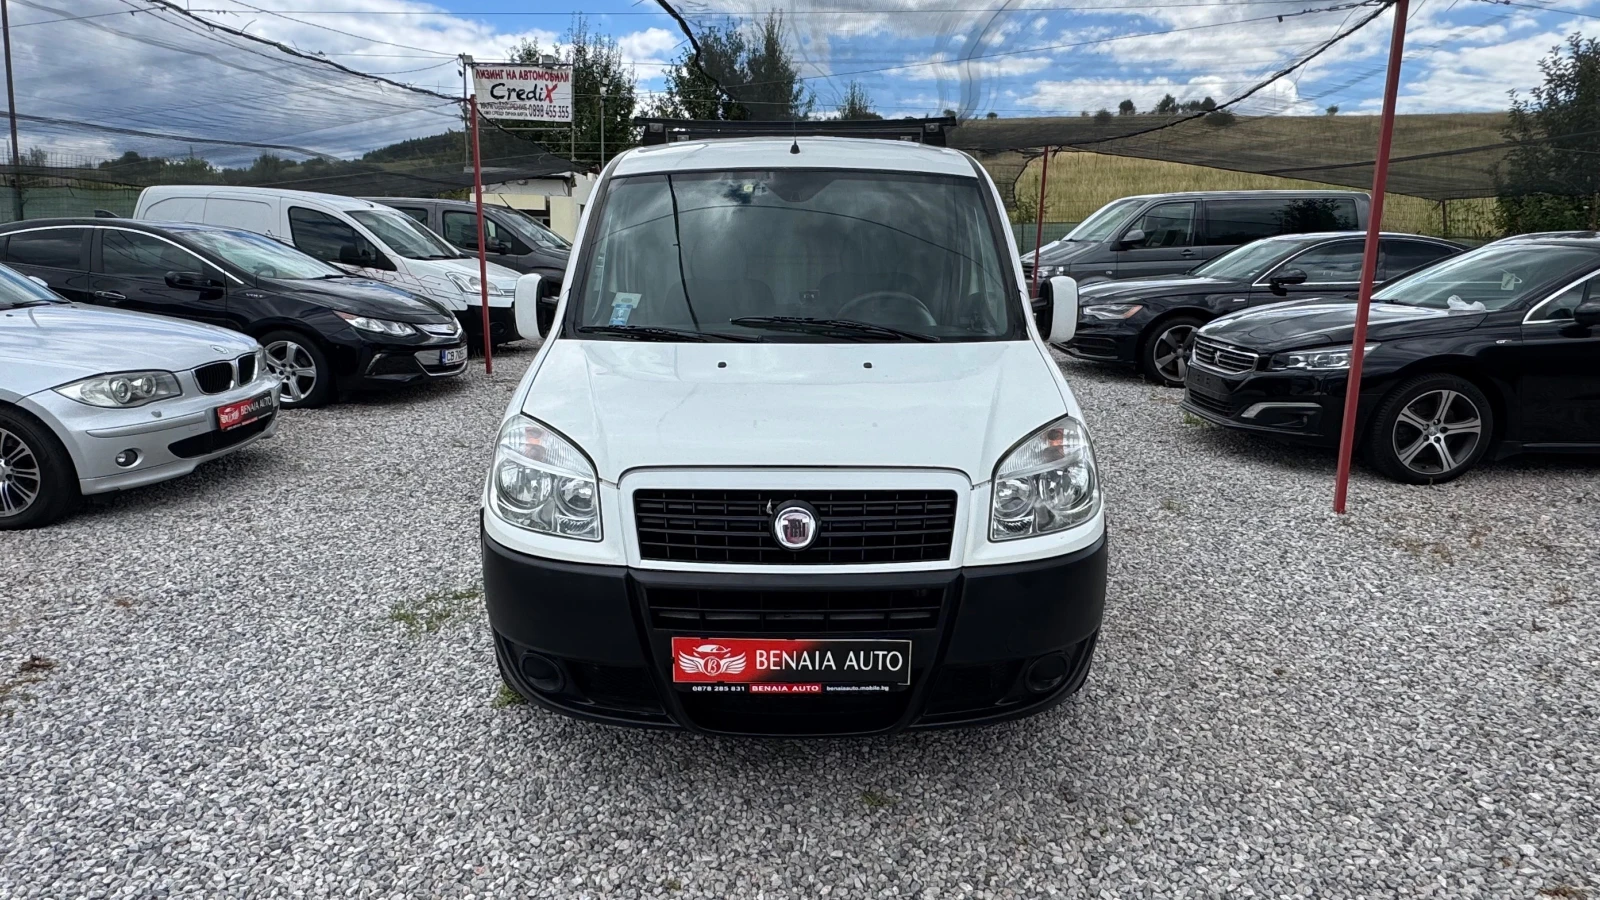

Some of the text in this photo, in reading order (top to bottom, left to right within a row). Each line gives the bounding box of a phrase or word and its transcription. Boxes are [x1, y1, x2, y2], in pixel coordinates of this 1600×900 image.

[476, 70, 569, 82] ЛИЗИНГ НА АВТОМОБИЛИ
[545, 105, 557, 118] 455
[557, 106, 569, 118] 355
[755, 649, 903, 672] BENAIA AUTO
